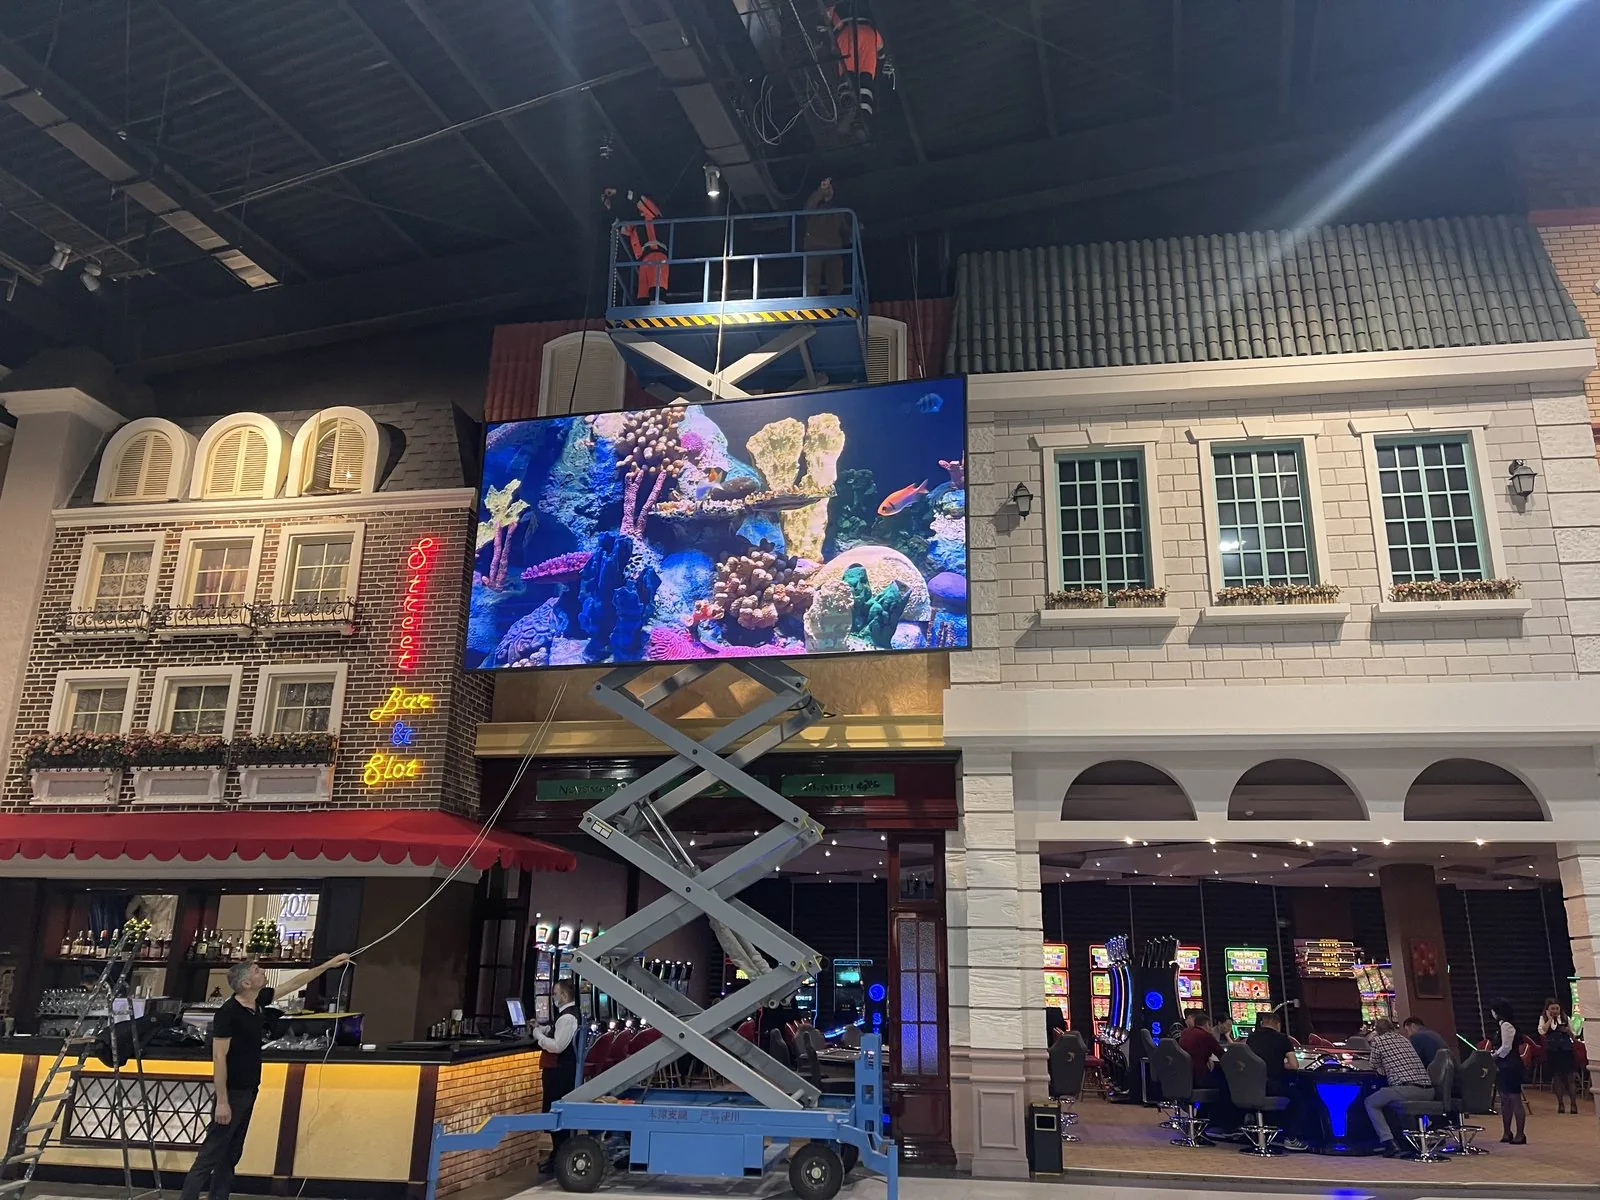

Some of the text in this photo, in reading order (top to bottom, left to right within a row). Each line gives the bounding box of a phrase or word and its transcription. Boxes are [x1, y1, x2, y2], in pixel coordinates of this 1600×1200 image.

[398, 537, 433, 668] Street
[369, 687, 430, 720] Bar
[392, 722, 412, 745] &
[363, 754, 417, 785] Slot
